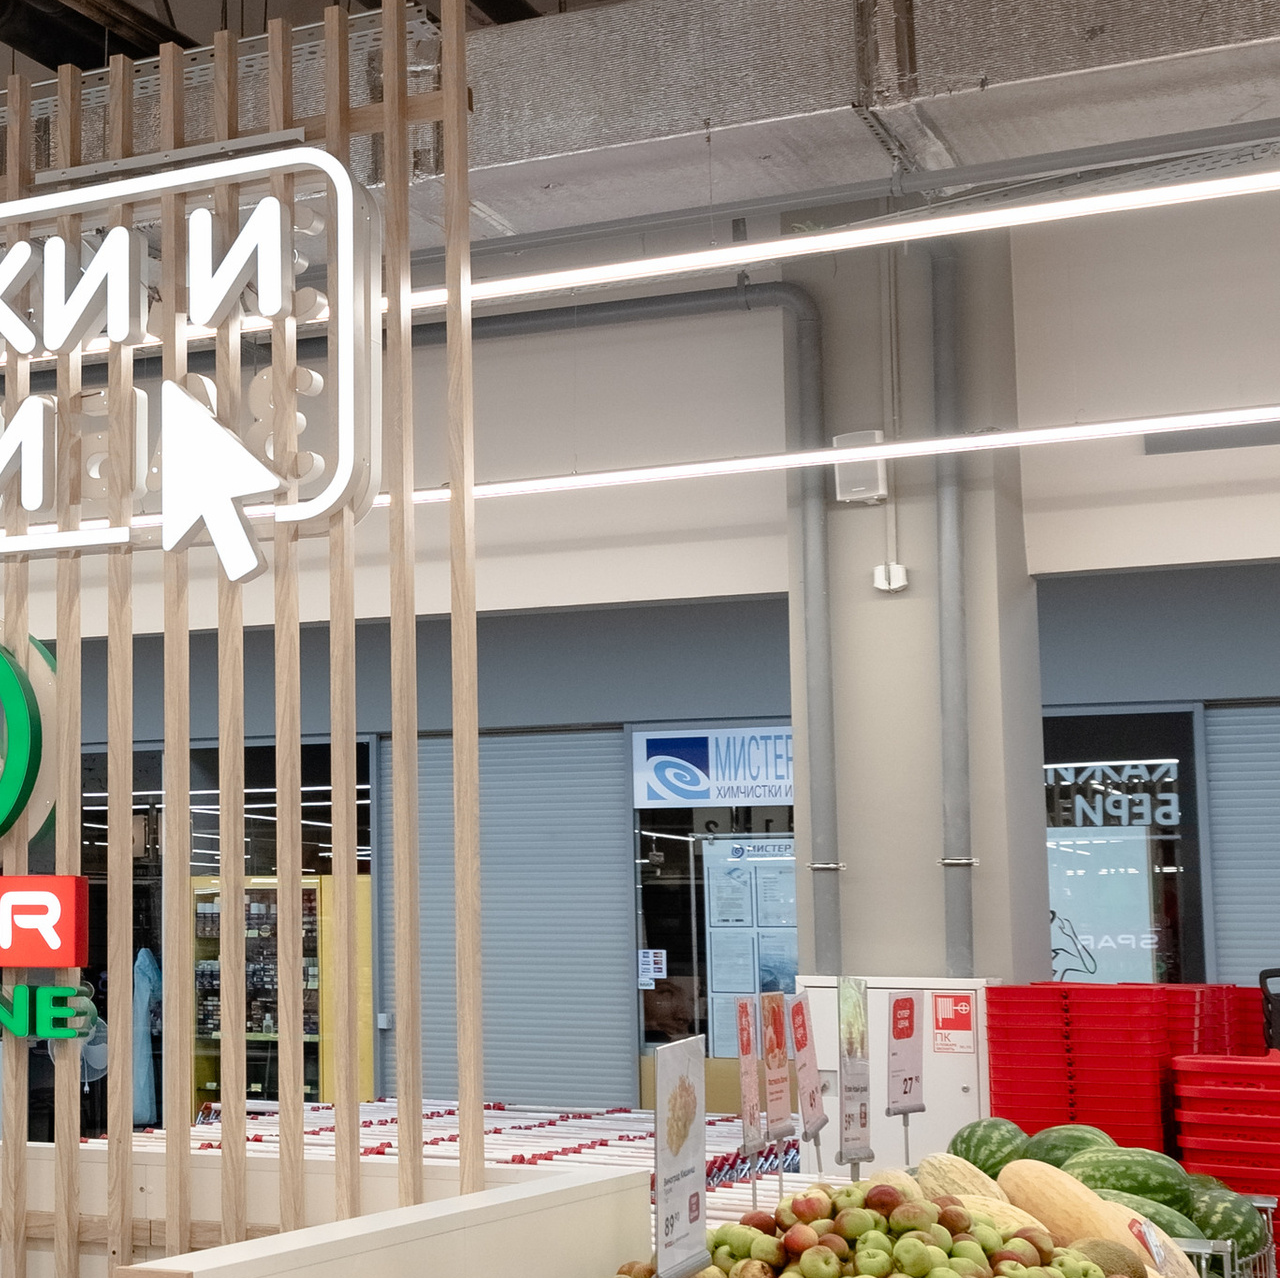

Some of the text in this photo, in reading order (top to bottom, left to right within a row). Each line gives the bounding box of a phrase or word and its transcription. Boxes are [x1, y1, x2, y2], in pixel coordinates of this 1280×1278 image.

[186, 196, 284, 326] И
[716, 784, 782, 799] ХИМЧИСТКИ
[935, 1032, 952, 1042] ПК
[902, 1077, 914, 1095] 27
[665, 1214, 675, 1237] 89
